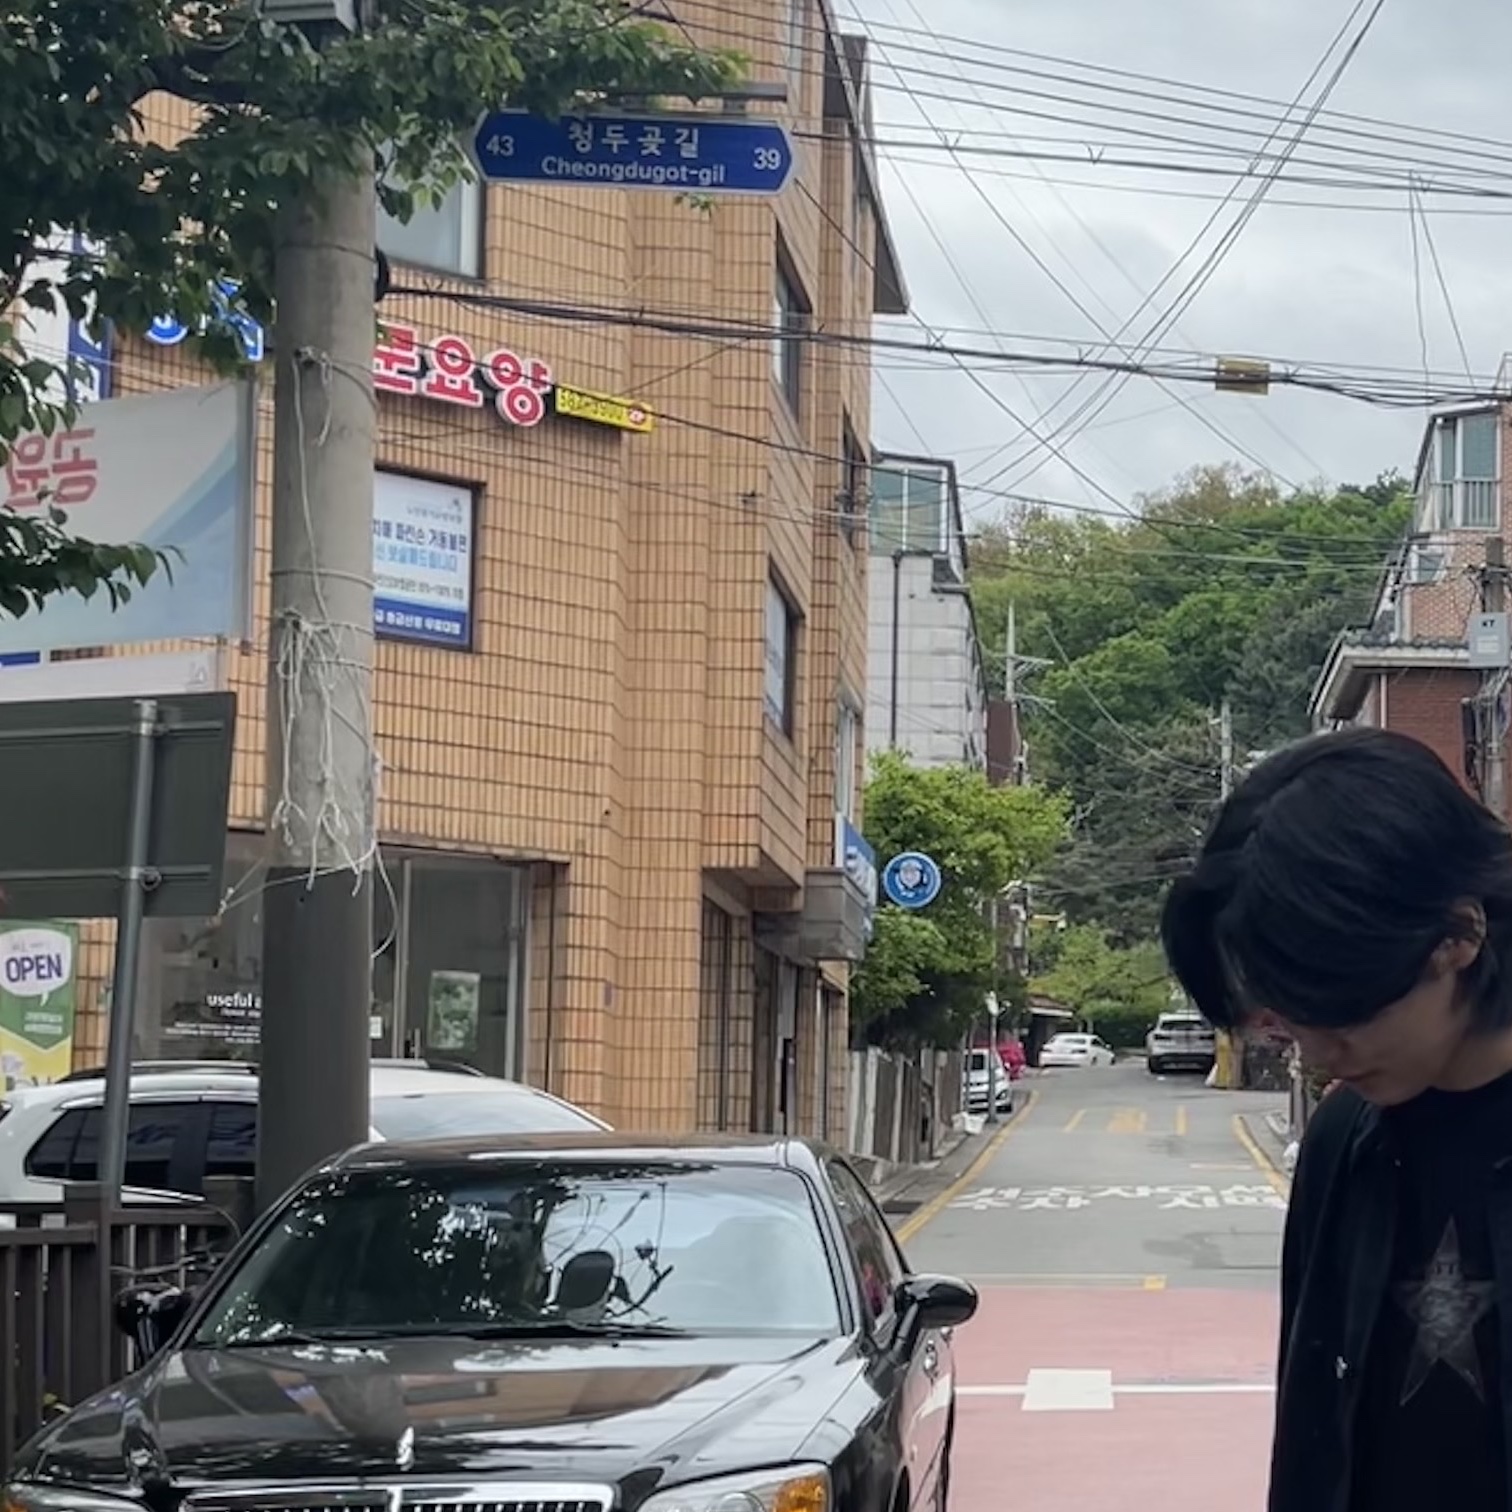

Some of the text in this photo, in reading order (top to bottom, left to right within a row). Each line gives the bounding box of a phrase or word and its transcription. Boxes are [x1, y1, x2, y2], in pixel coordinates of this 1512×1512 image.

[486, 134, 514, 157] 43
[541, 155, 725, 185] Cheongdugot-gil
[753, 146, 781, 170] 39
[5, 954, 63, 983] OPEN
[207, 993, 252, 1008] useful
